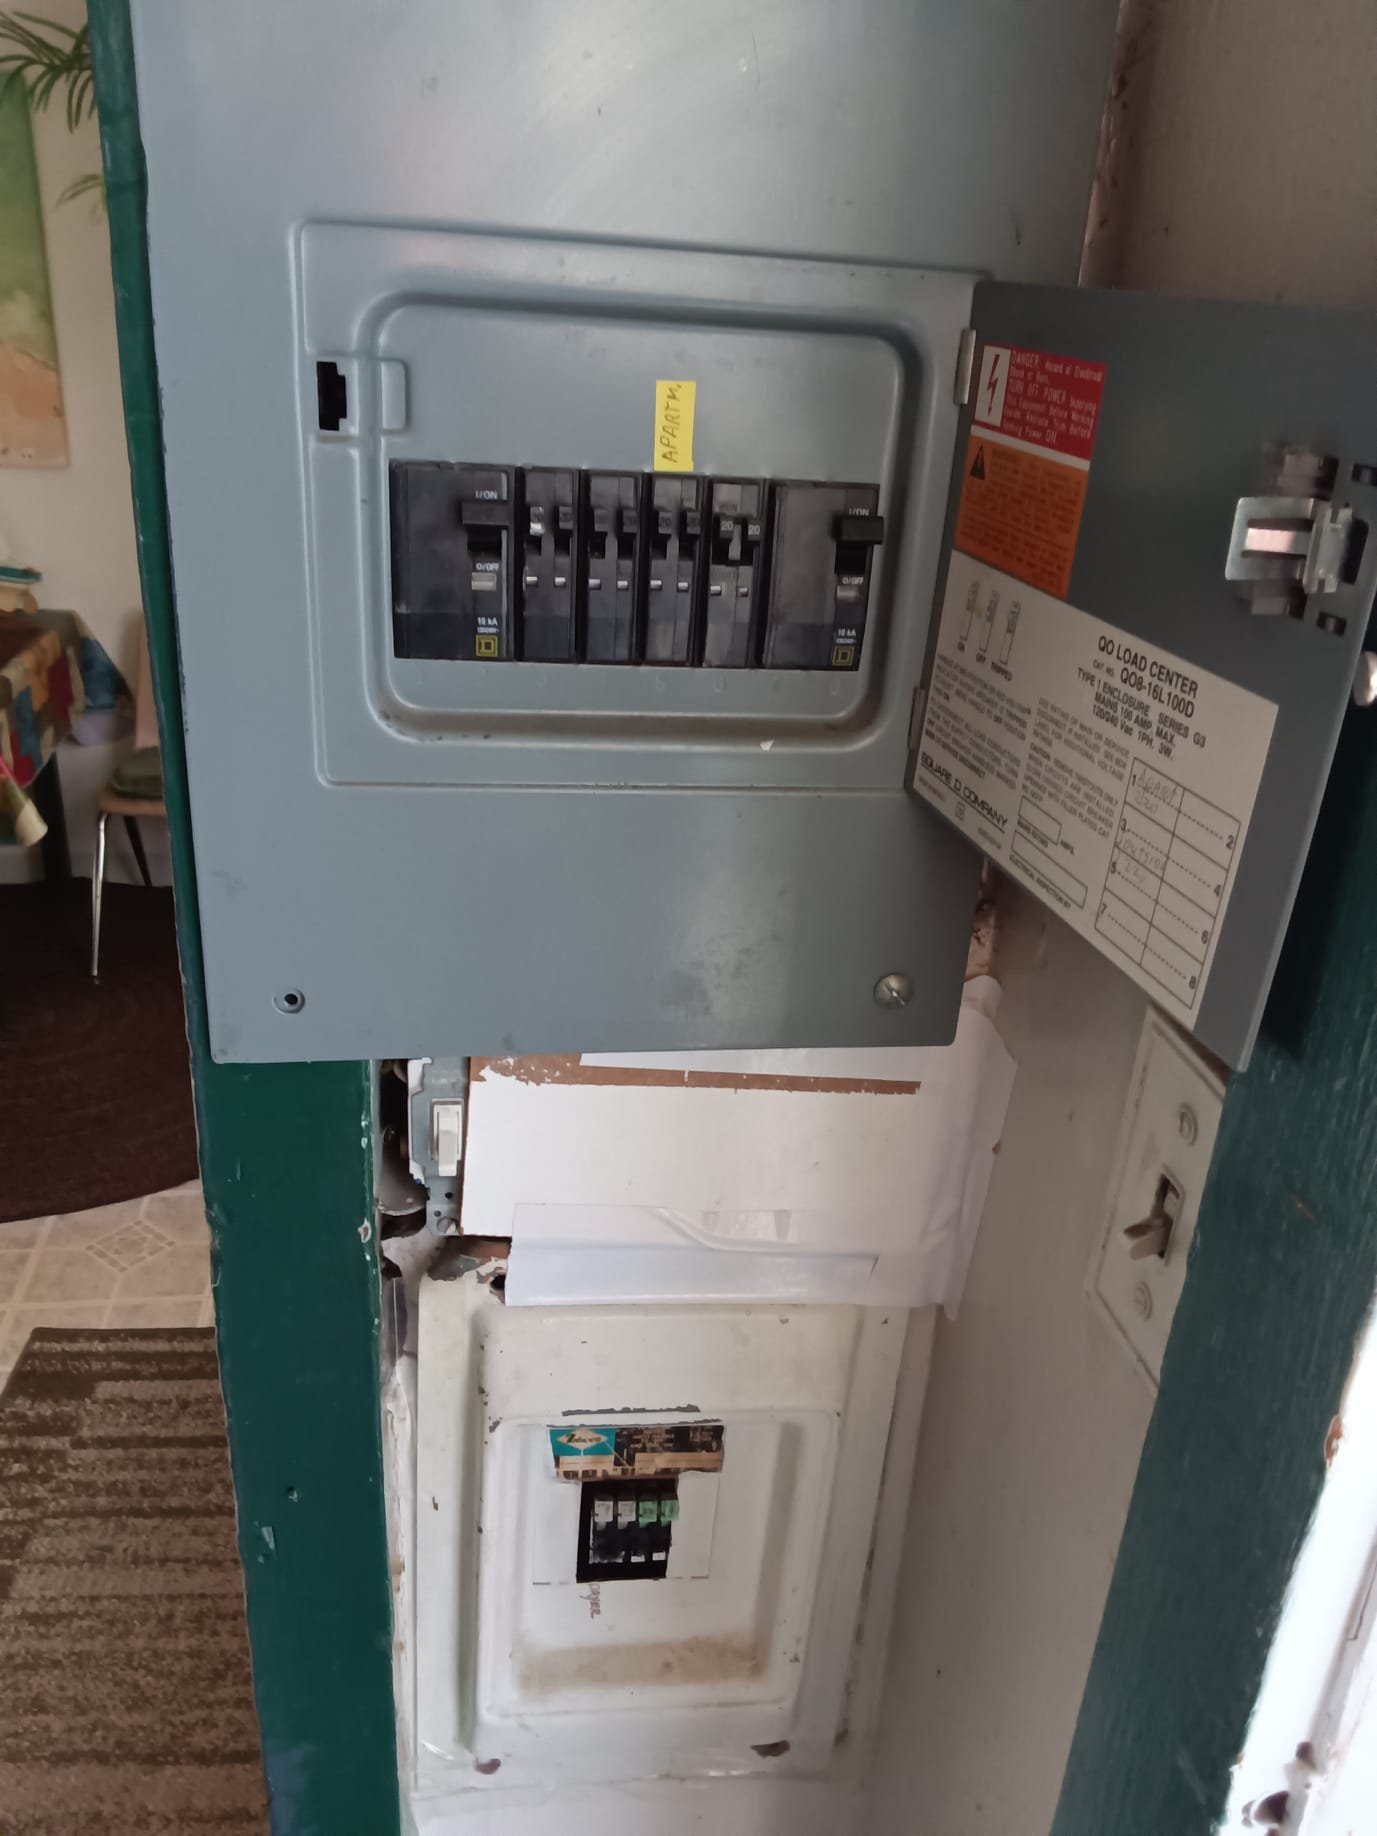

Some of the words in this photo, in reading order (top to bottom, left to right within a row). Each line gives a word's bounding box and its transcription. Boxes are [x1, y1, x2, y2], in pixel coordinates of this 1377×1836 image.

[1046, 430, 1057, 444] ON
[721, 521, 734, 530] 20
[748, 525, 760, 535] 20
[1097, 635, 1115, 656] QO
[1116, 643, 1148, 673] LOAD
[1149, 660, 1199, 700] CENTER
[1120, 667, 1195, 719] QO8-16L100D
[1077, 666, 1096, 688] TYPE
[1097, 676, 1102, 688] 1
[1102, 681, 1151, 718] ENCLOSURE
[1158, 711, 1190, 740] SERIES
[1094, 691, 1119, 714] MAINS
[1120, 704, 1133, 722] 100
[1155, 725, 1176, 749] MAX.
[1092, 703, 1119, 728] 120/240
[1158, 742, 1174, 761] 3W.
[1132, 775, 1137, 788] 1
[921, 751, 953, 786] SQUARE
[953, 778, 962, 792] D
[963, 786, 1009, 829] COMPANY
[1121, 818, 1127, 831] 3
[1226, 834, 1234, 849] 2
[1213, 884, 1222, 897] 4
[1100, 904, 1107, 916] 7
[1201, 929, 1209, 945] 6
[1189, 975, 1197, 990] 8
